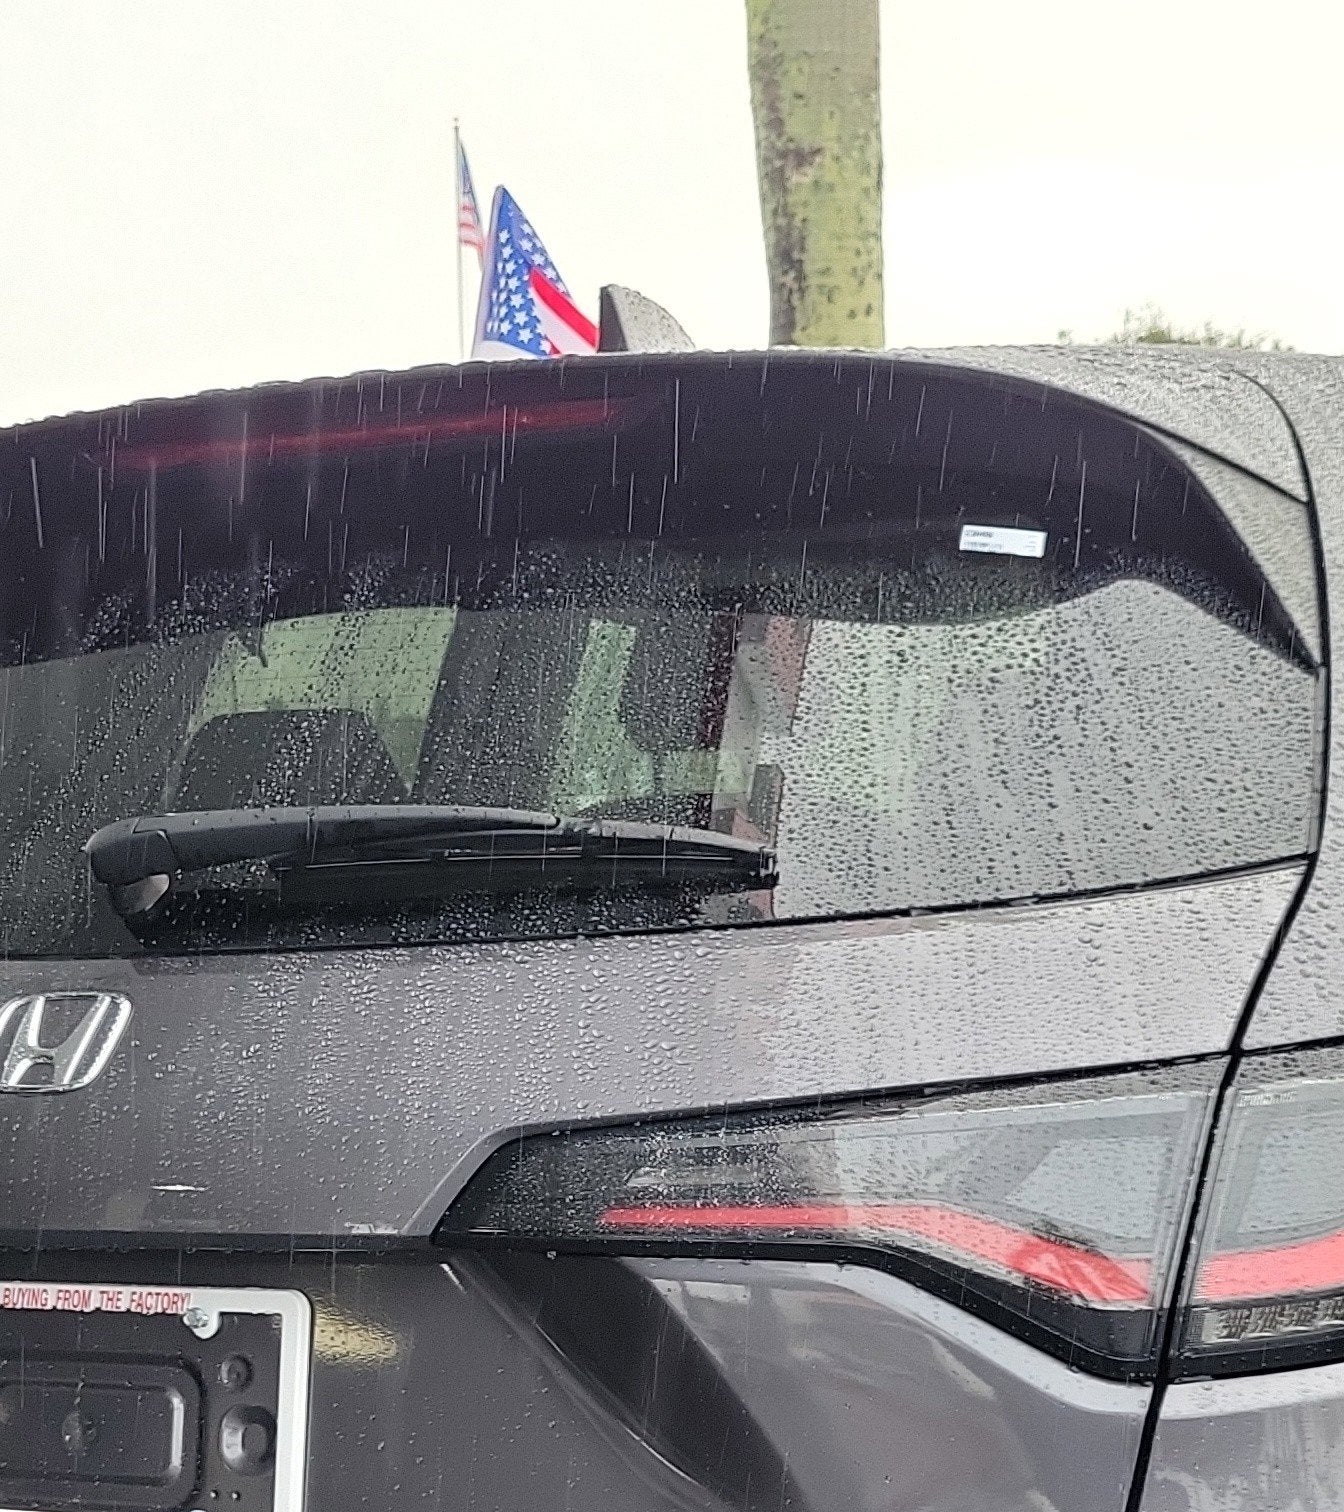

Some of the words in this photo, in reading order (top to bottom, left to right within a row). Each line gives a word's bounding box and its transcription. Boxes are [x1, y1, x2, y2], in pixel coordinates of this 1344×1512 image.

[3, 1288, 50, 1308] BUYING
[57, 1289, 92, 1310] FROM
[100, 1290, 123, 1310] THE
